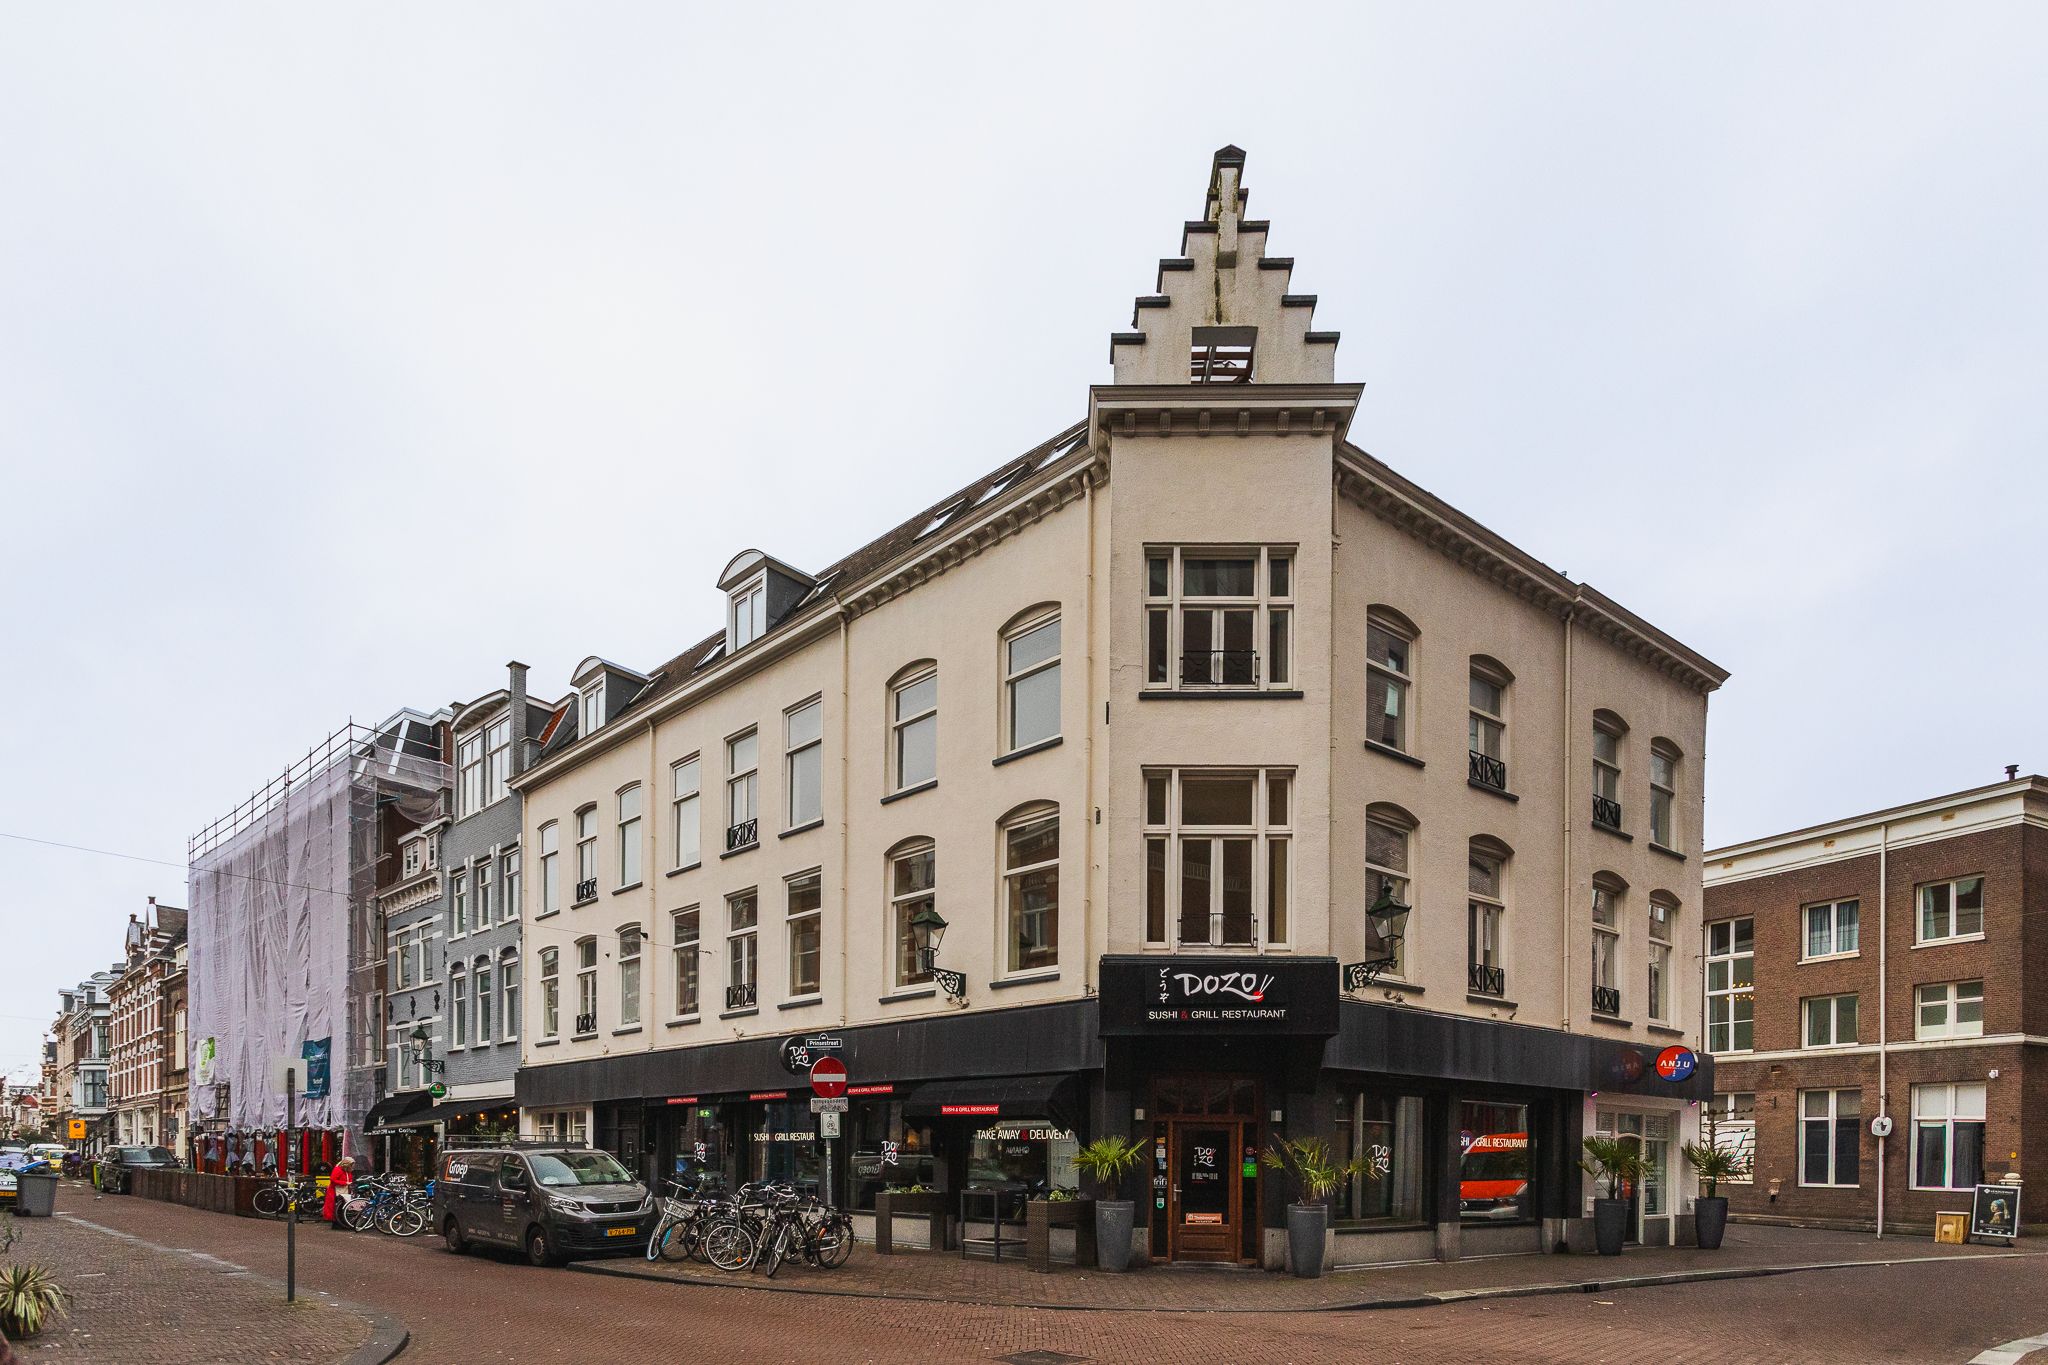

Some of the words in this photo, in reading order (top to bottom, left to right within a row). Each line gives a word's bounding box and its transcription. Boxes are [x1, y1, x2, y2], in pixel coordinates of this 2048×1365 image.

[1173, 972, 1264, 1001] DOZO
[1148, 1010, 1178, 1020] SUSHI
[1191, 1010, 1219, 1019] GRILL
[1221, 1009, 1286, 1019] RESTAURANT
[1660, 1060, 1691, 1068] ANJU
[753, 1133, 769, 1141] SUSHI
[775, 1133, 789, 1141] GRILL
[790, 1132, 815, 1141] RESTAUR
[977, 1129, 996, 1140] TAKE
[998, 1129, 1020, 1140] AWAY
[1030, 1129, 1070, 1140] DELIVERY
[1476, 1138, 1491, 1147] GRILL
[1493, 1138, 1528, 1148] RESTAURANT
[449, 1161, 468, 1178] Groep
